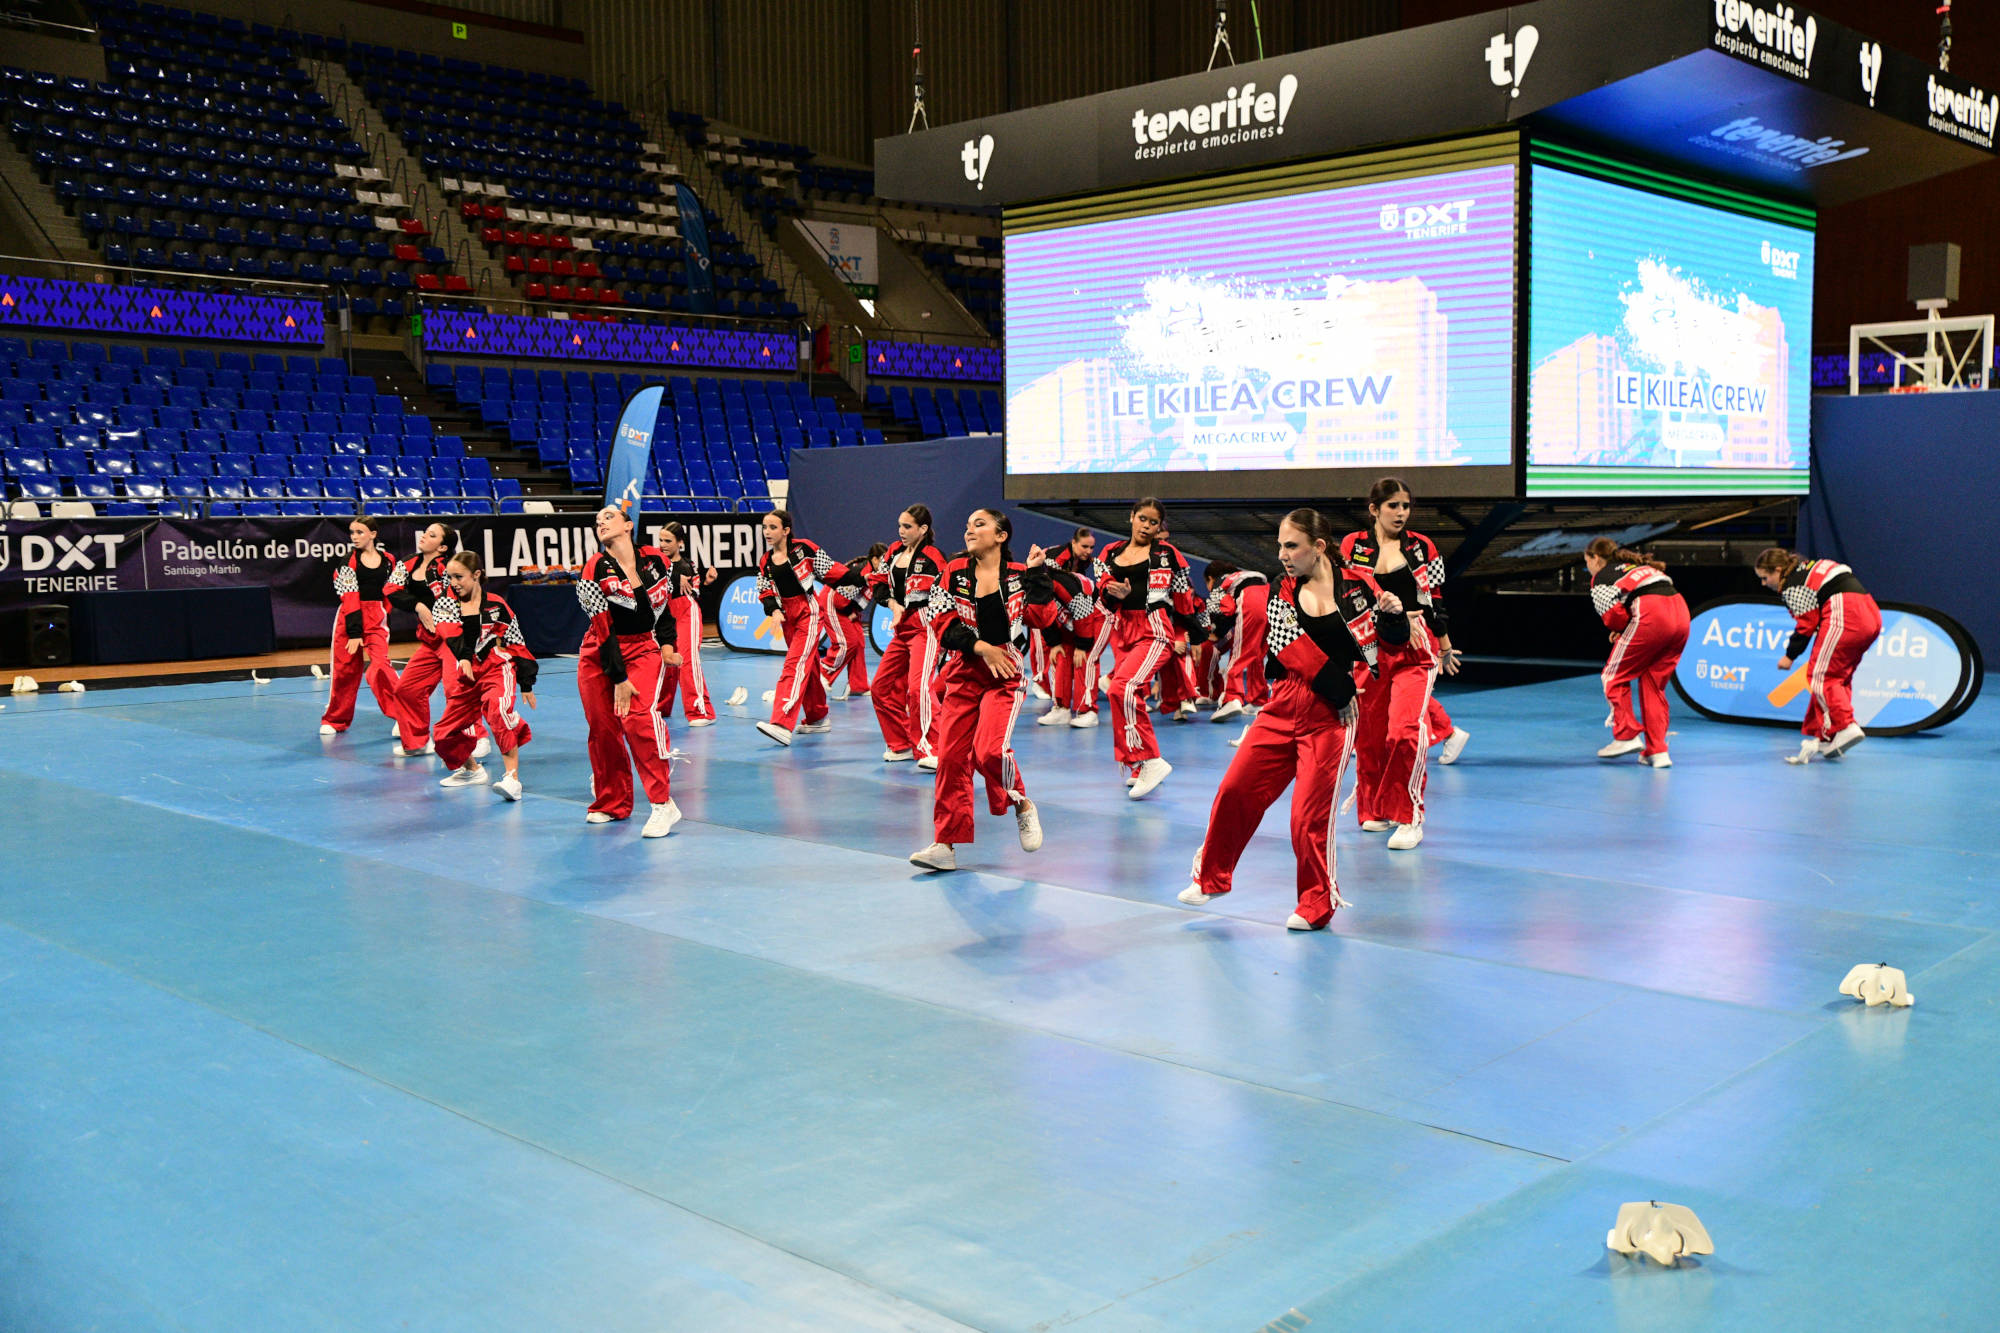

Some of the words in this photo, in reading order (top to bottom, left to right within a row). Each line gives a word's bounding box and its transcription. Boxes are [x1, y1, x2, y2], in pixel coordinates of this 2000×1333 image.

[1715, 28, 1758, 60] despierta
[1760, 49, 1804, 78] emociones
[1135, 140, 1196, 160] despierta
[1202, 126, 1274, 148] emociones
[1404, 200, 1475, 228] DXT
[1405, 222, 1467, 239] TENERIFE
[1772, 248, 1800, 271] DXT
[1113, 390, 1144, 416] LE
[1158, 382, 1258, 414] KILEA
[1272, 375, 1392, 409] CREW
[1617, 376, 1638, 405] LE
[1648, 379, 1704, 409] KILEA
[1712, 384, 1766, 413] CREW
[628, 428, 650, 442] DXT
[1193, 431, 1287, 445] MEGACREW
[22, 534, 125, 572] DXT
[162, 538, 257, 561] Pabellón
[264, 540, 289, 559] de
[295, 539, 385, 562] Depors
[164, 565, 206, 577] Santiago
[209, 564, 241, 575] Martín
[24, 576, 118, 593] TENERIFE
[1710, 664, 1750, 682] DXT
